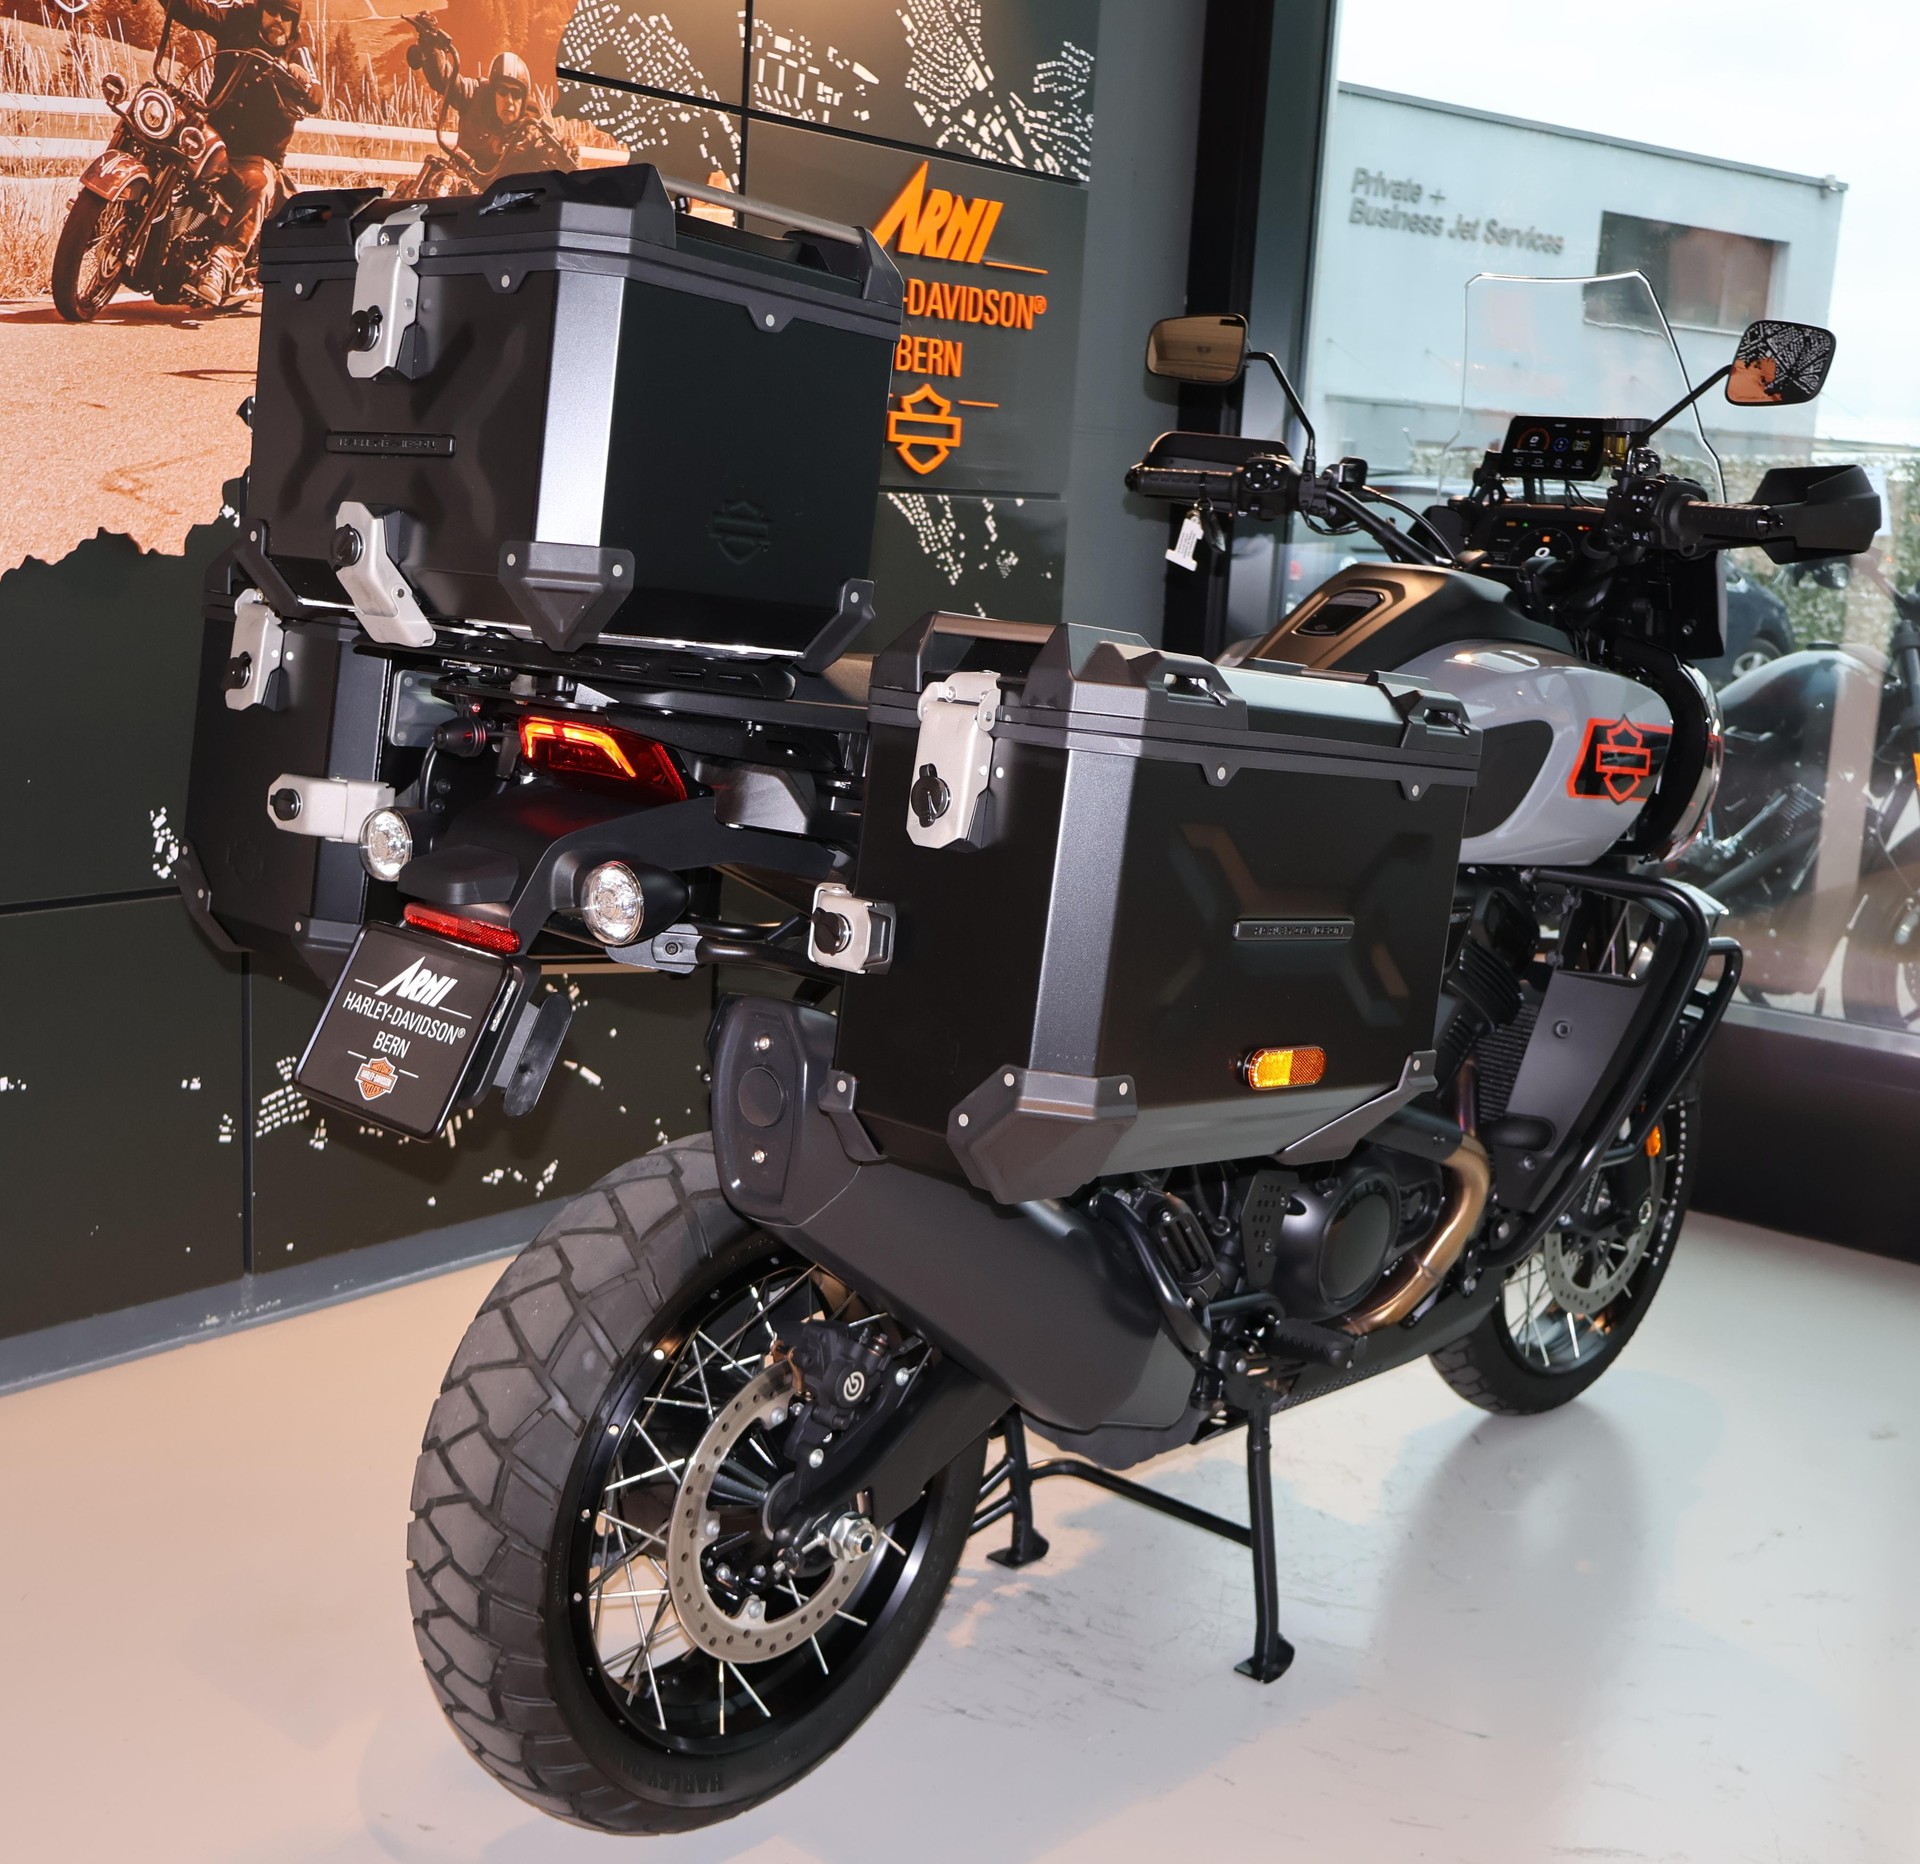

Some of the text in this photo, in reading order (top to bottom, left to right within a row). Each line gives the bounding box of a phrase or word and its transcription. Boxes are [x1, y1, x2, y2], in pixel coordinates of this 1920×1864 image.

[1351, 167, 1423, 204] Private
[872, 160, 1004, 264] ARNI
[1348, 197, 1565, 255] Business Jet Services
[895, 333, 963, 377] BERN
[375, 956, 458, 1007] ARNI
[372, 1030, 411, 1059] BERN
